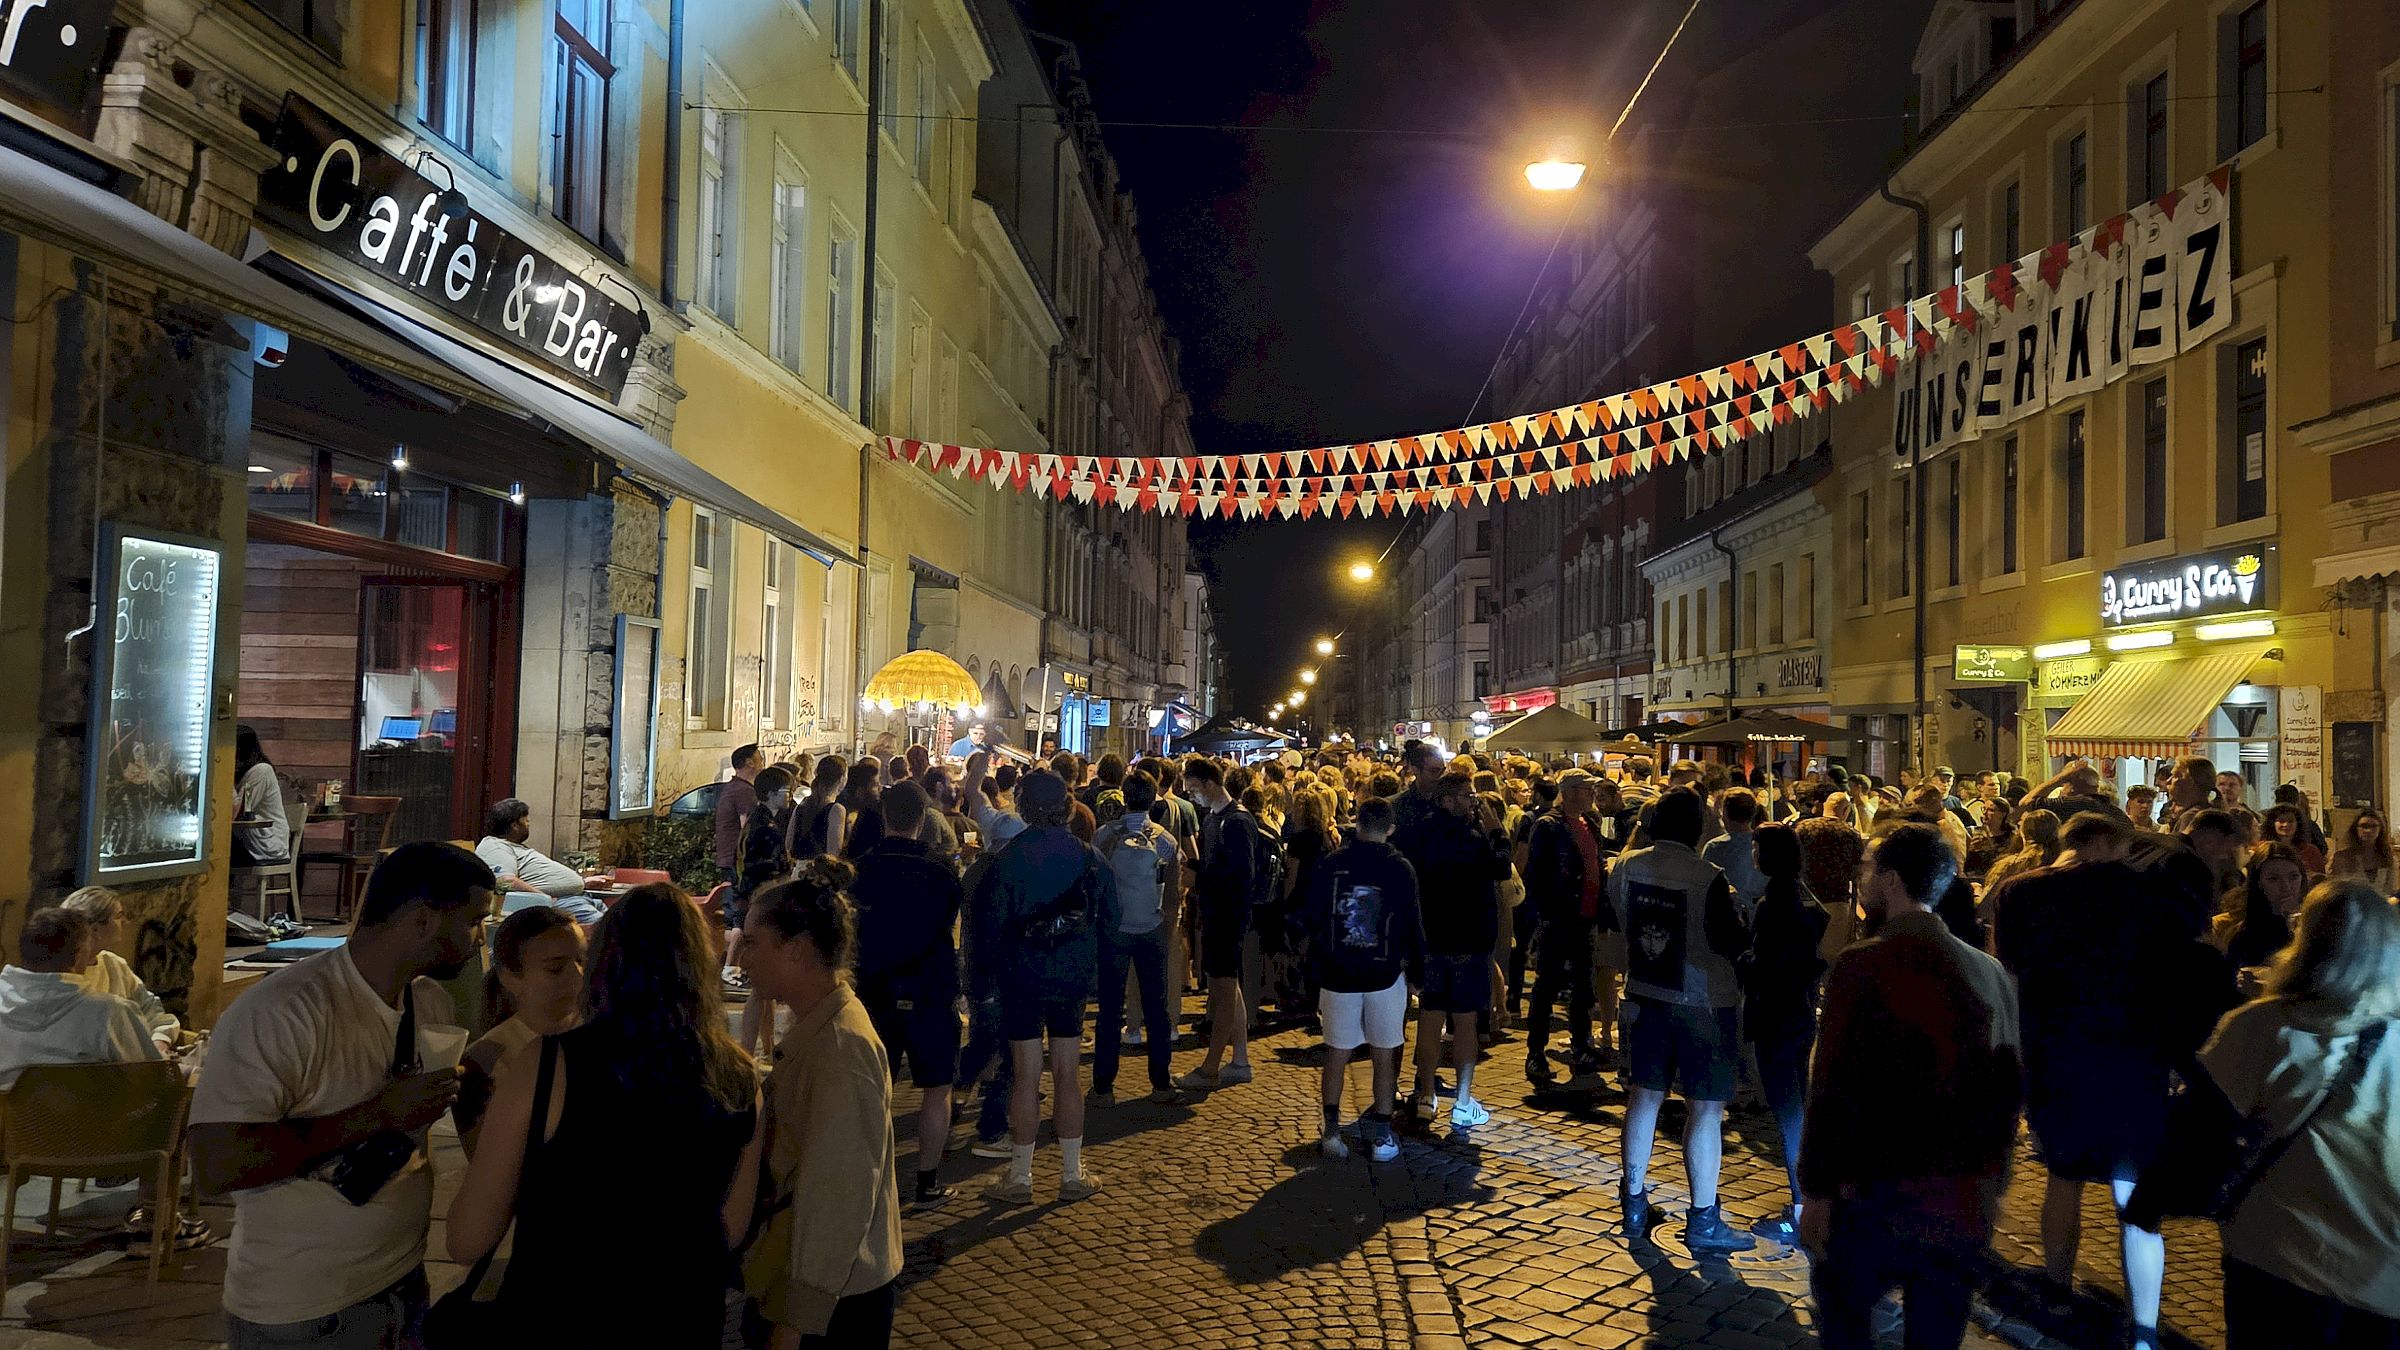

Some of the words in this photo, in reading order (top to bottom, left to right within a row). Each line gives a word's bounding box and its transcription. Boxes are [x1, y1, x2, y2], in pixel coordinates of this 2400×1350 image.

[502, 254, 534, 339] &
[543, 280, 618, 377] Bar
[1895, 324, 2038, 457] UNSER
[2065, 222, 2221, 382] KIEZ
[126, 556, 177, 605] Café
[2123, 577, 2182, 610] Curry
[1778, 655, 1821, 688] ROASTERY
[1962, 668, 1987, 678] Curry
[2051, 661, 2074, 675] GEILER
